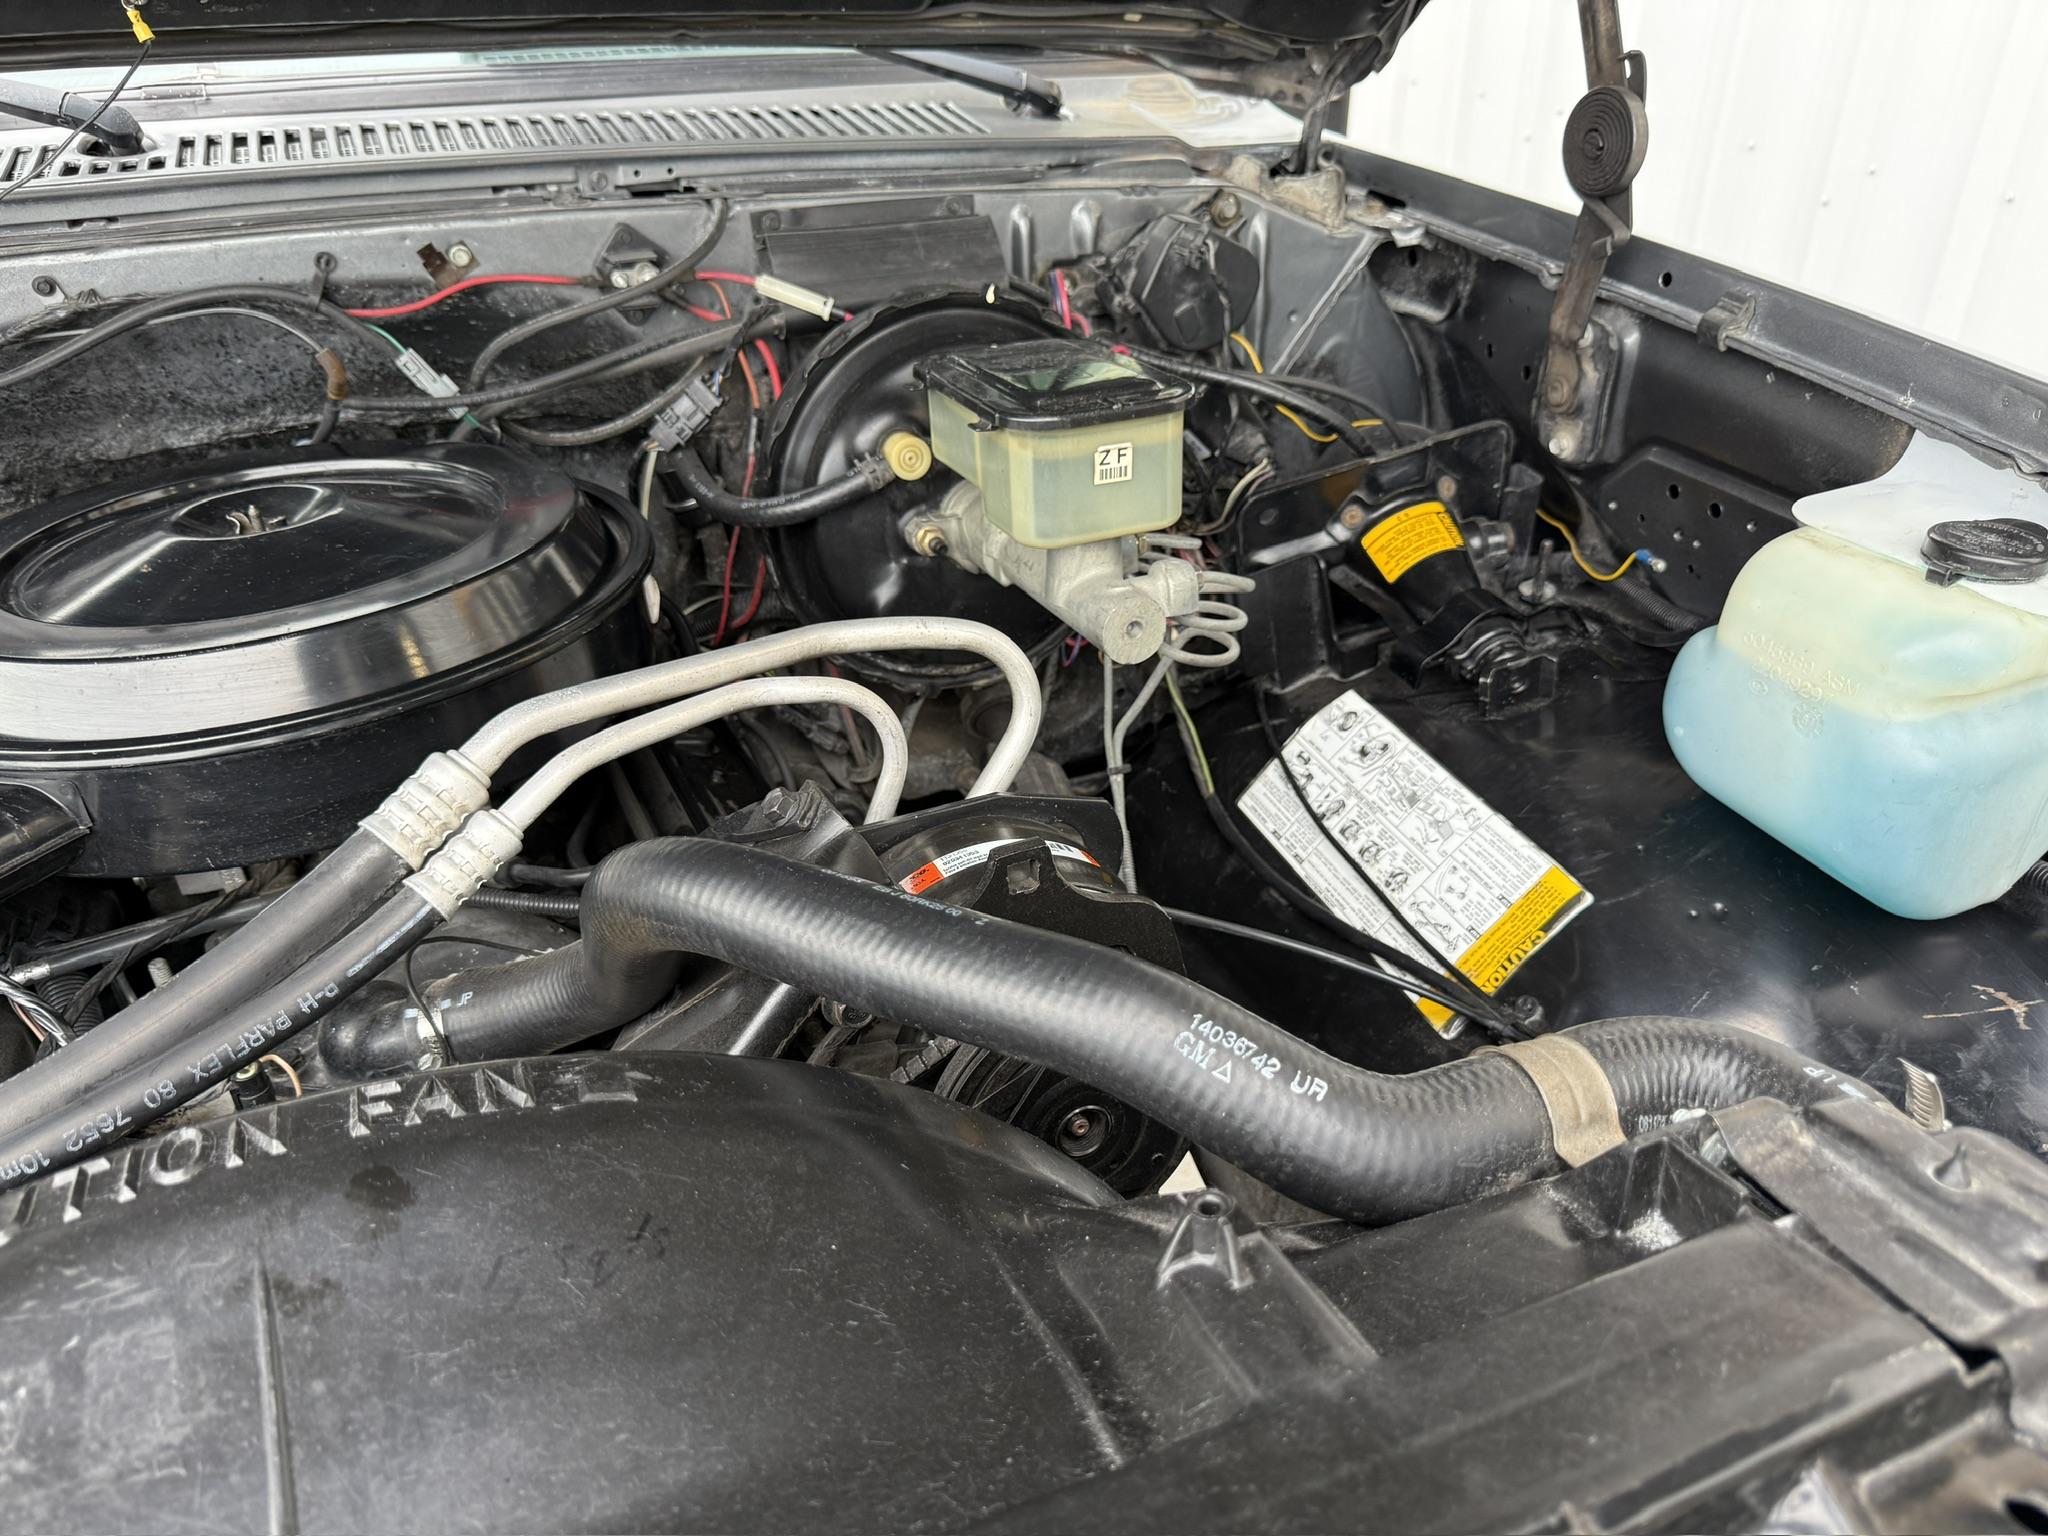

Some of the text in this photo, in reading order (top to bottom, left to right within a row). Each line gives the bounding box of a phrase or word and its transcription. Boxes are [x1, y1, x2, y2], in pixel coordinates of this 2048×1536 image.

[1480, 929, 1548, 995] CAUTION
[186, 1009, 294, 1084] PARFLEX
[1173, 1030, 1217, 1070] GM
[1189, 1013, 1282, 1081] 14036742
[143, 1079, 178, 1109] 80
[349, 1060, 537, 1139] FAN
[63, 1104, 133, 1152] 7652
